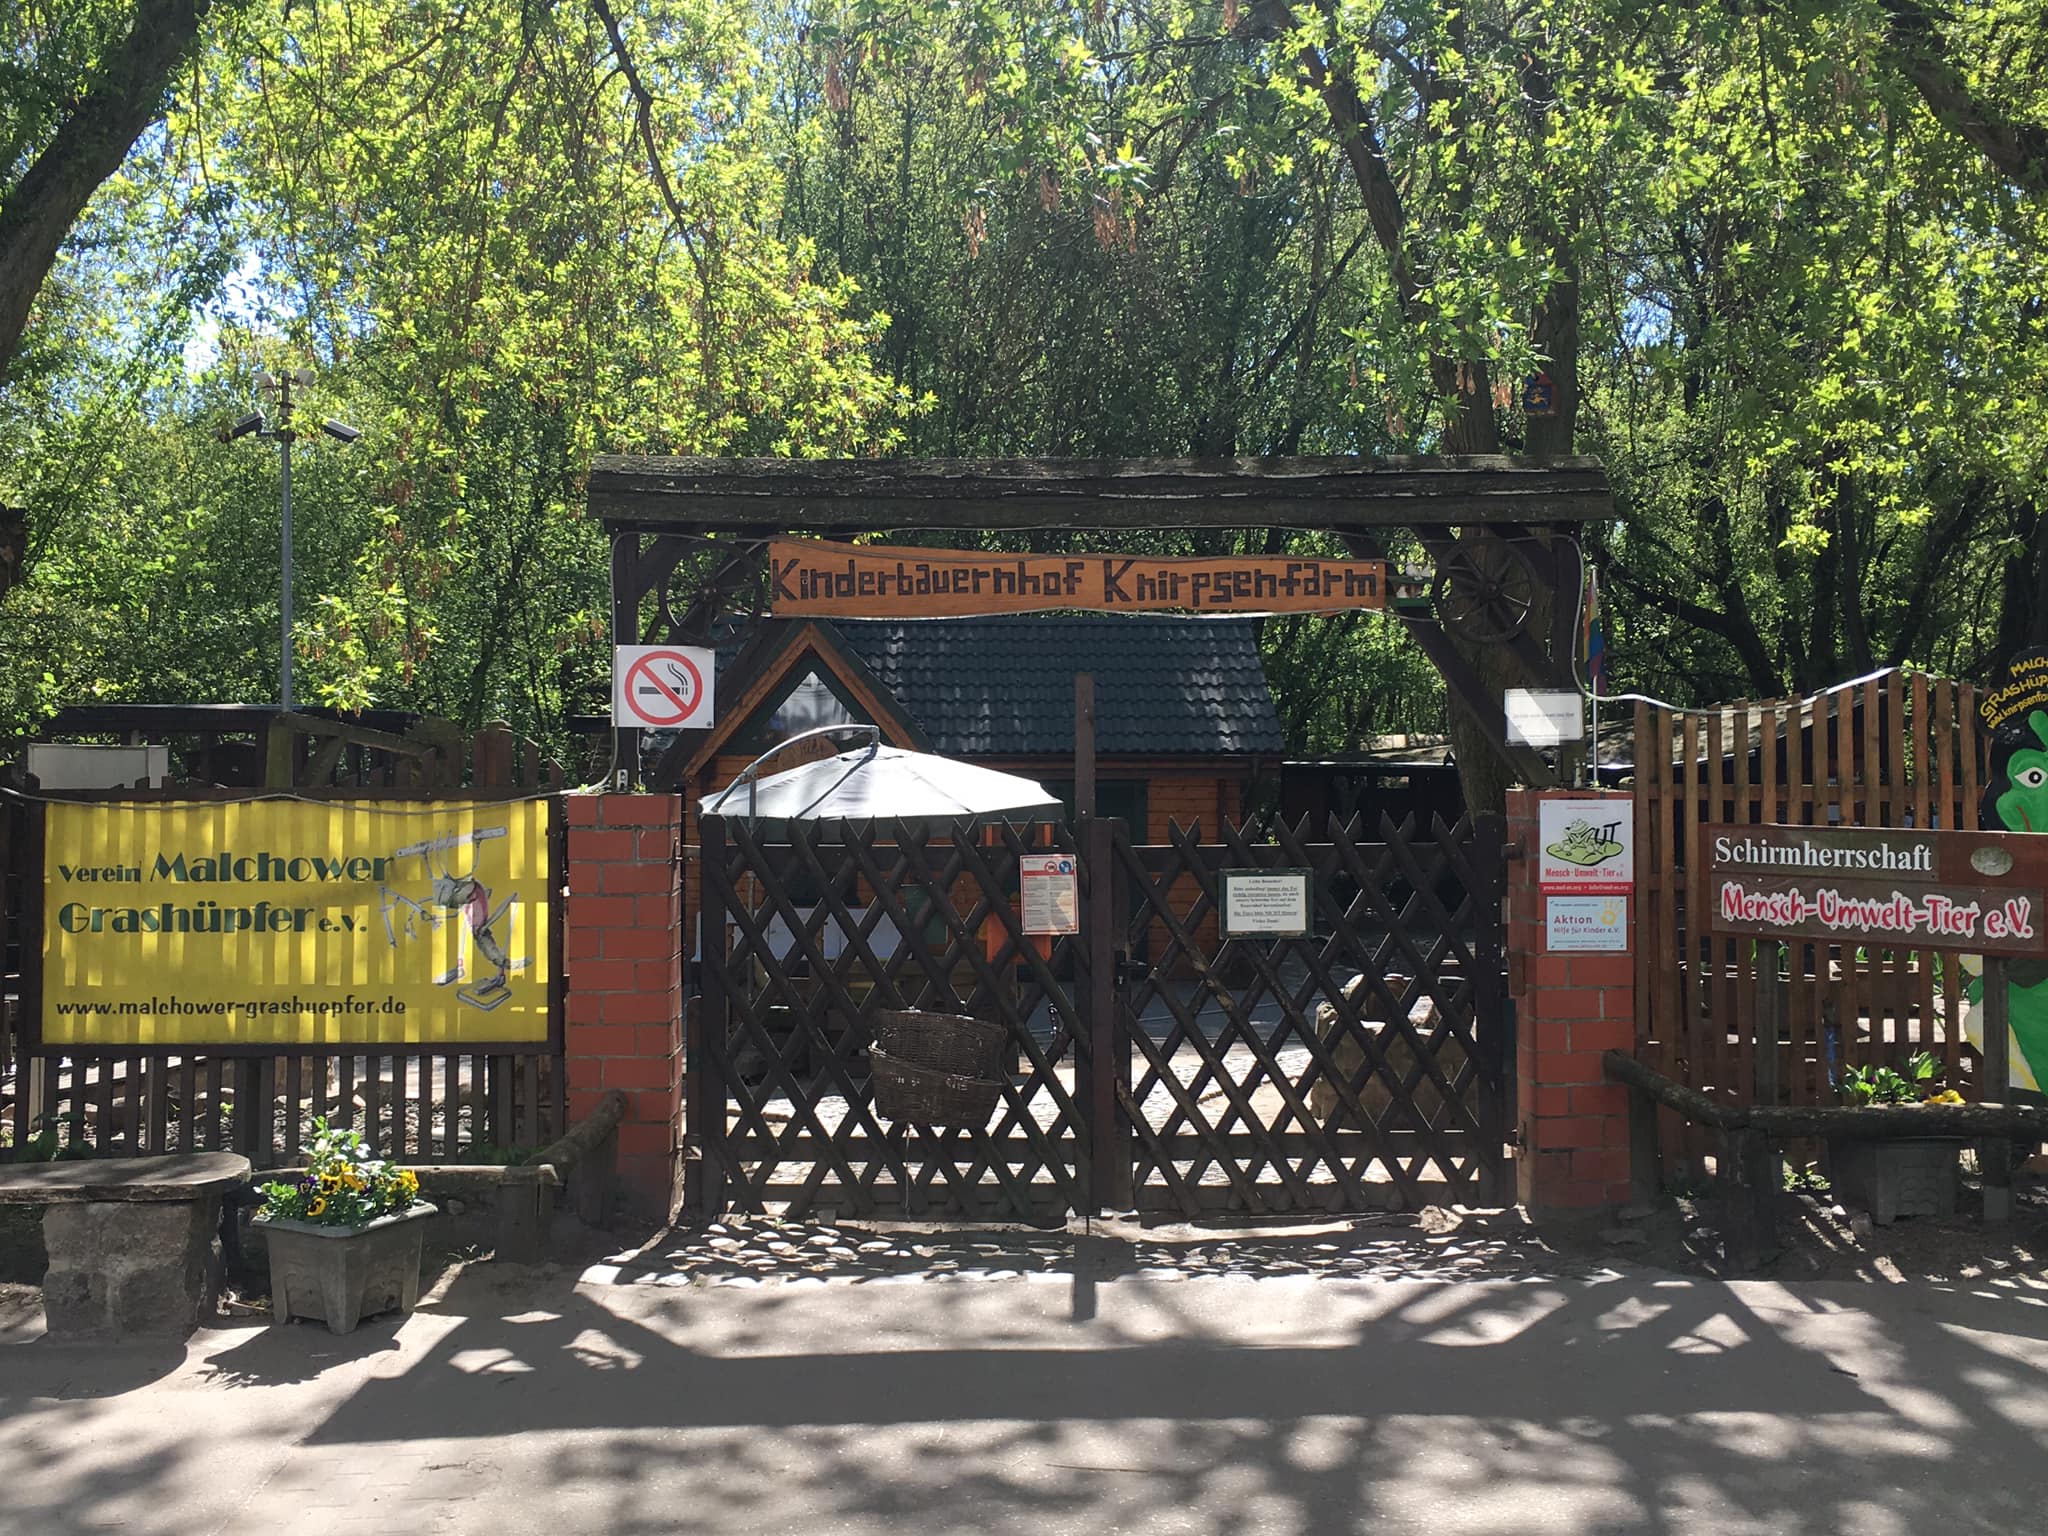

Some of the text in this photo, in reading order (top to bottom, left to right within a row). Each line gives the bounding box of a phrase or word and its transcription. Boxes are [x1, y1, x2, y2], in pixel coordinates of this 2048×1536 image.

[771, 558, 1377, 607] Kinderbauernhof Knirpsenfarm
[58, 852, 395, 883] Verein Malchower
[1715, 837, 1933, 872] Schirmherrschaft
[1545, 868, 1570, 877] Mensch
[59, 901, 315, 933] Grashüpfer
[1554, 914, 1593, 924] Aktion
[1722, 884, 2033, 937] Mensch-Umwelt-Tier e.V.
[57, 995, 406, 1018] www.malchower-grashuepfer.de
